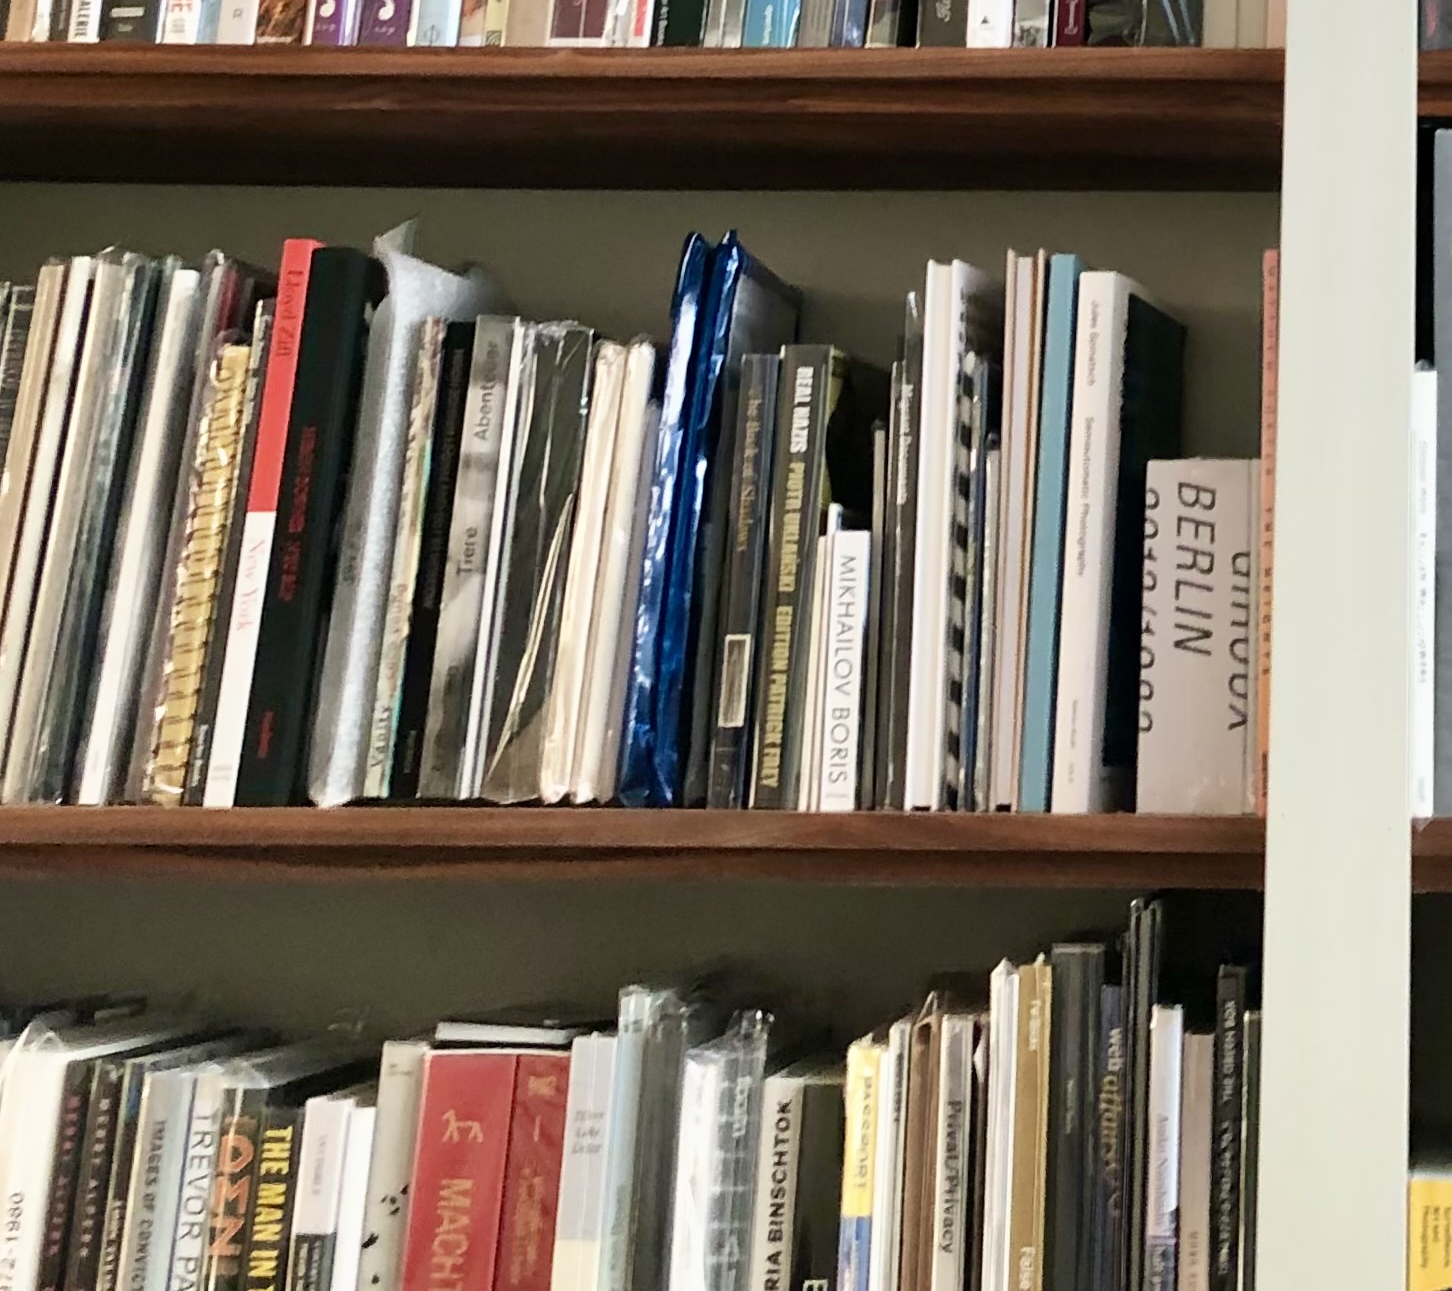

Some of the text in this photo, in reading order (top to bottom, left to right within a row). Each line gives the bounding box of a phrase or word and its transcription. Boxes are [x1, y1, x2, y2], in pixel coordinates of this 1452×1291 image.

[474, 341, 500, 443] Abenteuer
[792, 366, 815, 404] REAL
[788, 406, 812, 453] NAZIS
[783, 462, 807, 510] PIOTR
[458, 526, 478, 578] Tiere
[1172, 481, 1216, 658] BERLIN
[235, 538, 266, 633] New York
[770, 605, 795, 669] EDITION
[828, 554, 859, 785] MIKHAILOV BORIS
[764, 672, 789, 744] PATRICK
[760, 747, 783, 789] FREY
[1107, 1028, 1124, 1071] web
[143, 1119, 168, 1187] IMAGES
[178, 1110, 218, 1242] TREVOR
[768, 1099, 793, 1244] BINSCHTOK
[143, 1193, 159, 1212] OF
[248, 1126, 294, 1280] THE MAN IN
[1018, 1246, 1035, 1289] False
